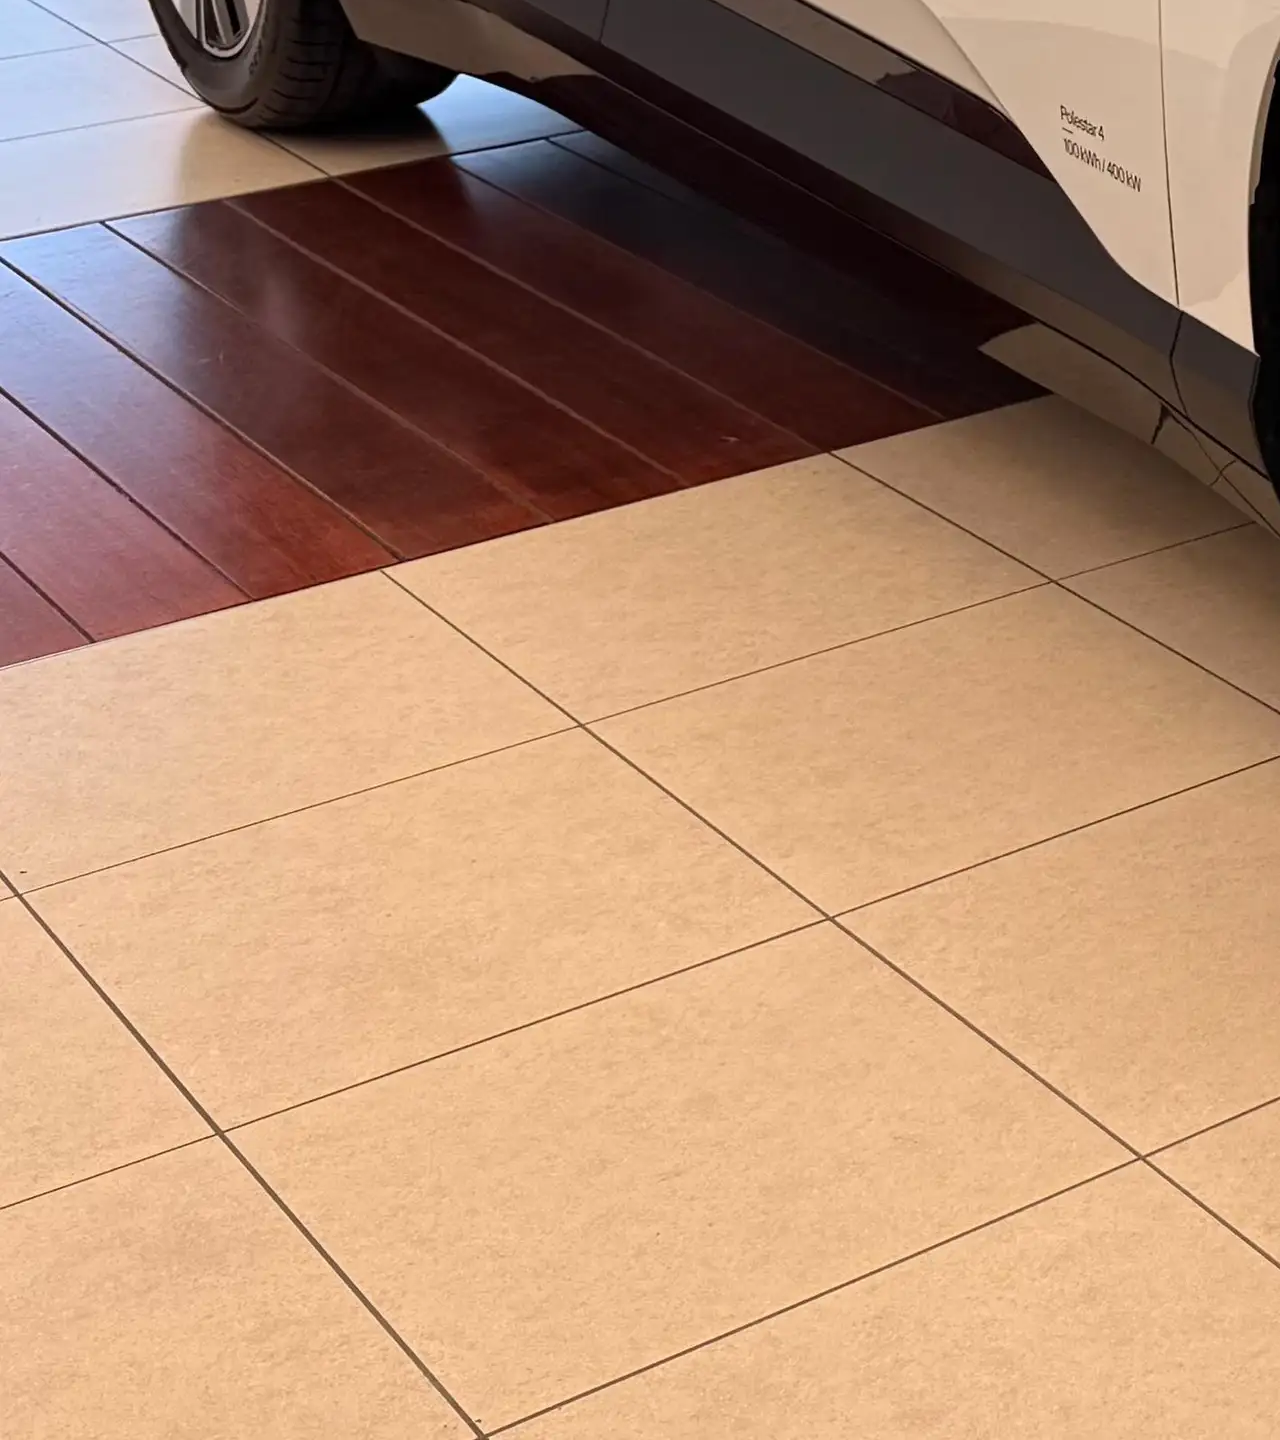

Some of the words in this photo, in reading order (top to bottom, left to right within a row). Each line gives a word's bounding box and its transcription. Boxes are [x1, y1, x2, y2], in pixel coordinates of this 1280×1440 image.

[1060, 104, 1097, 137] Polestar
[1098, 125, 1105, 141] 4
[1063, 138, 1080, 159] 100
[1106, 161, 1125, 184] 400
[1126, 170, 1141, 193] kW
